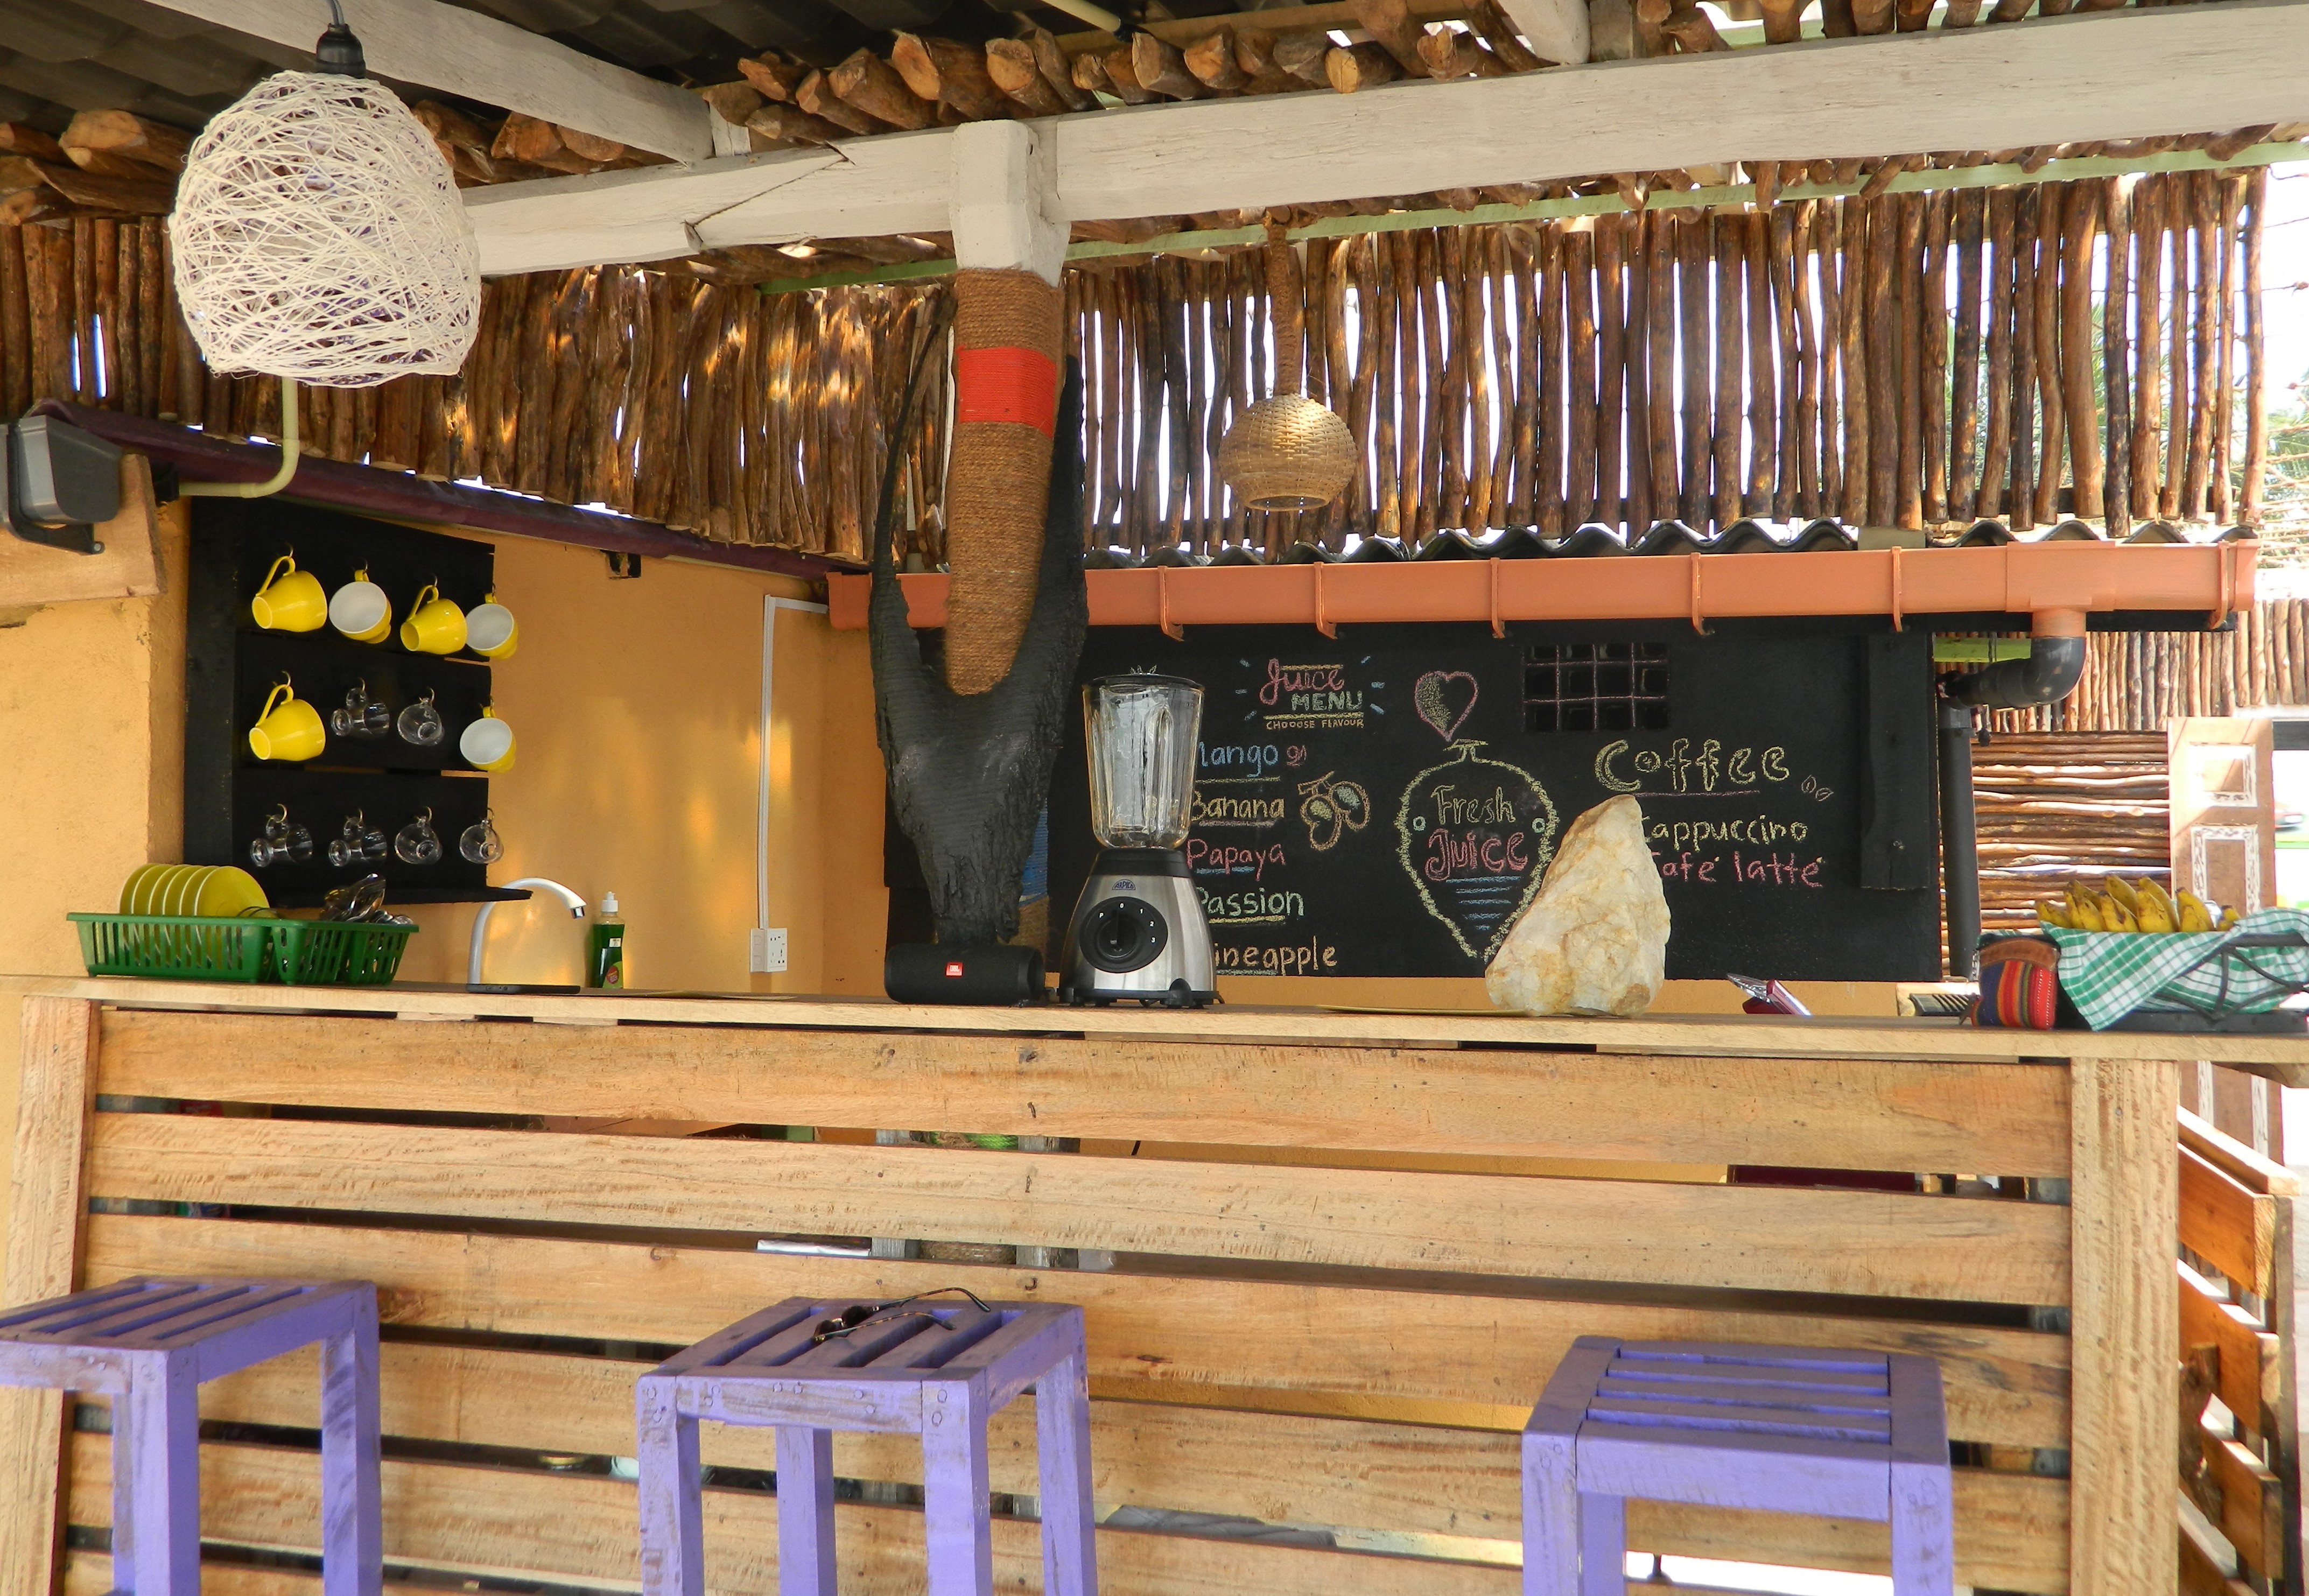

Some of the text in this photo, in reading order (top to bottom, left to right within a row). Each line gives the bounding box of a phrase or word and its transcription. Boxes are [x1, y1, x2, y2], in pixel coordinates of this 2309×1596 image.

[1259, 658, 1345, 705] Juice
[1291, 690, 1363, 711] MENU
[1321, 719, 1364, 728] FLAVOUR
[1594, 737, 1790, 792] Coffee
[1430, 784, 1516, 825] Fresh
[1642, 814, 1808, 852] appuccino
[1187, 838, 1286, 882] Papaya
[1425, 828, 1528, 881] Juice
[1651, 851, 1720, 882] afé
[1214, 935, 1337, 976] ineapple
